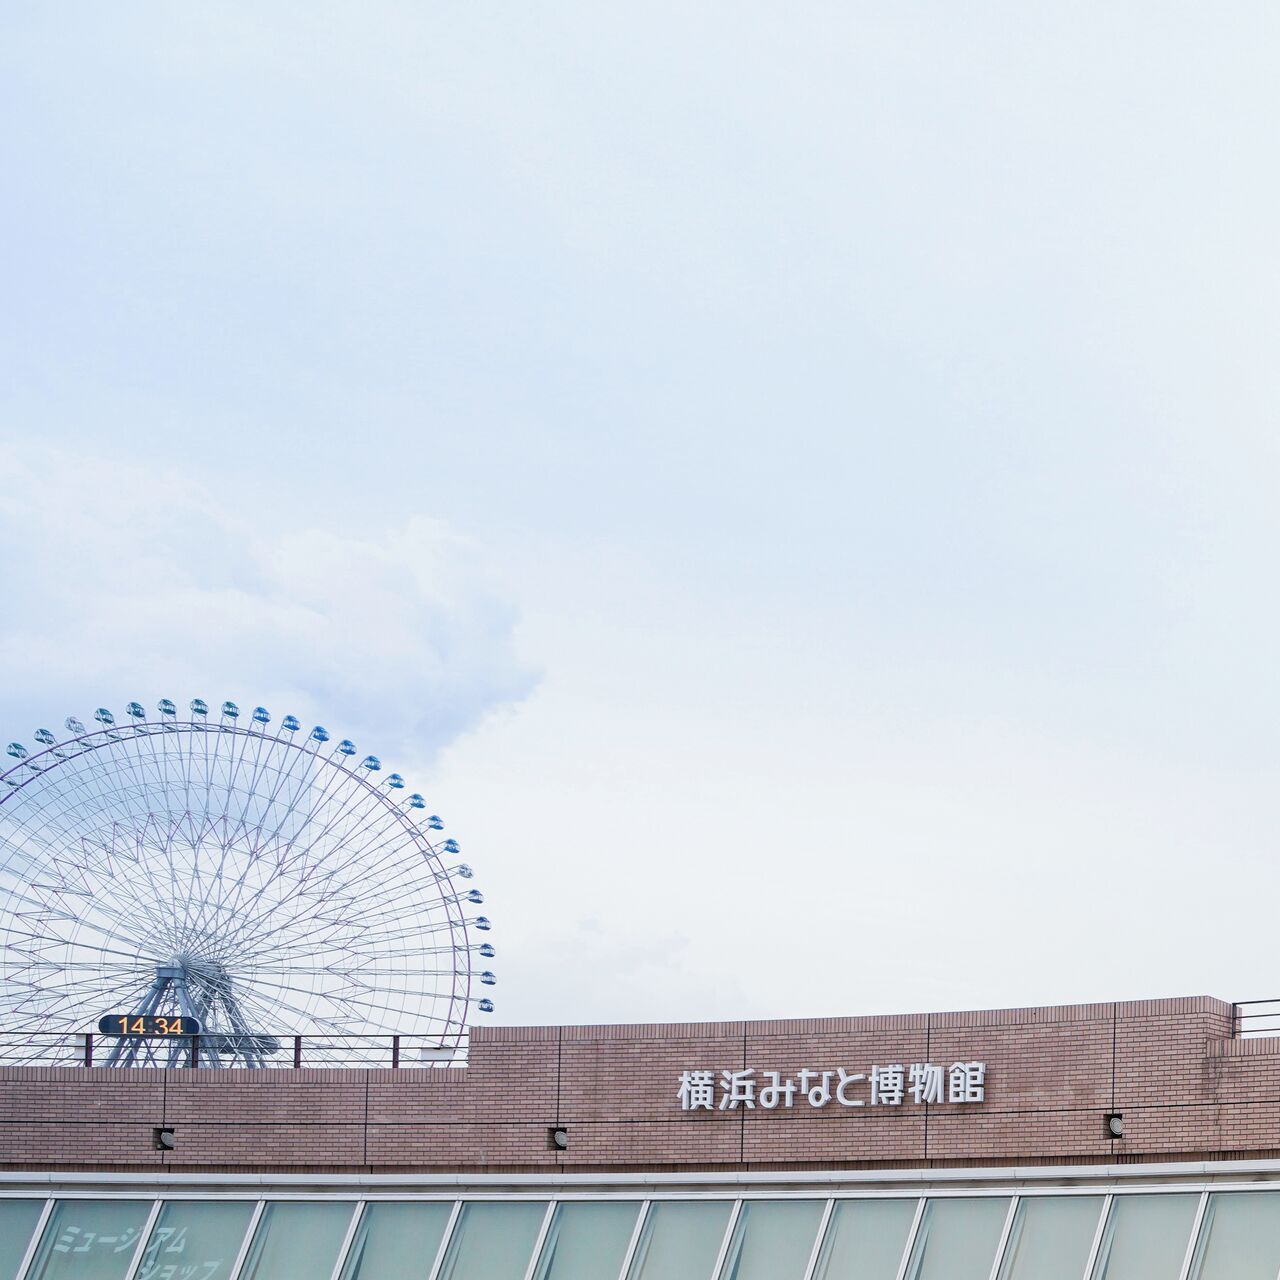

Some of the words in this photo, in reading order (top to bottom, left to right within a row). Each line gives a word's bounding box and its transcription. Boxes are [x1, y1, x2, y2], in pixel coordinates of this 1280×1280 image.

[676, 1061, 987, 1110] 横浜みなと博物館
[53, 1225, 189, 1254] ミュージアム
